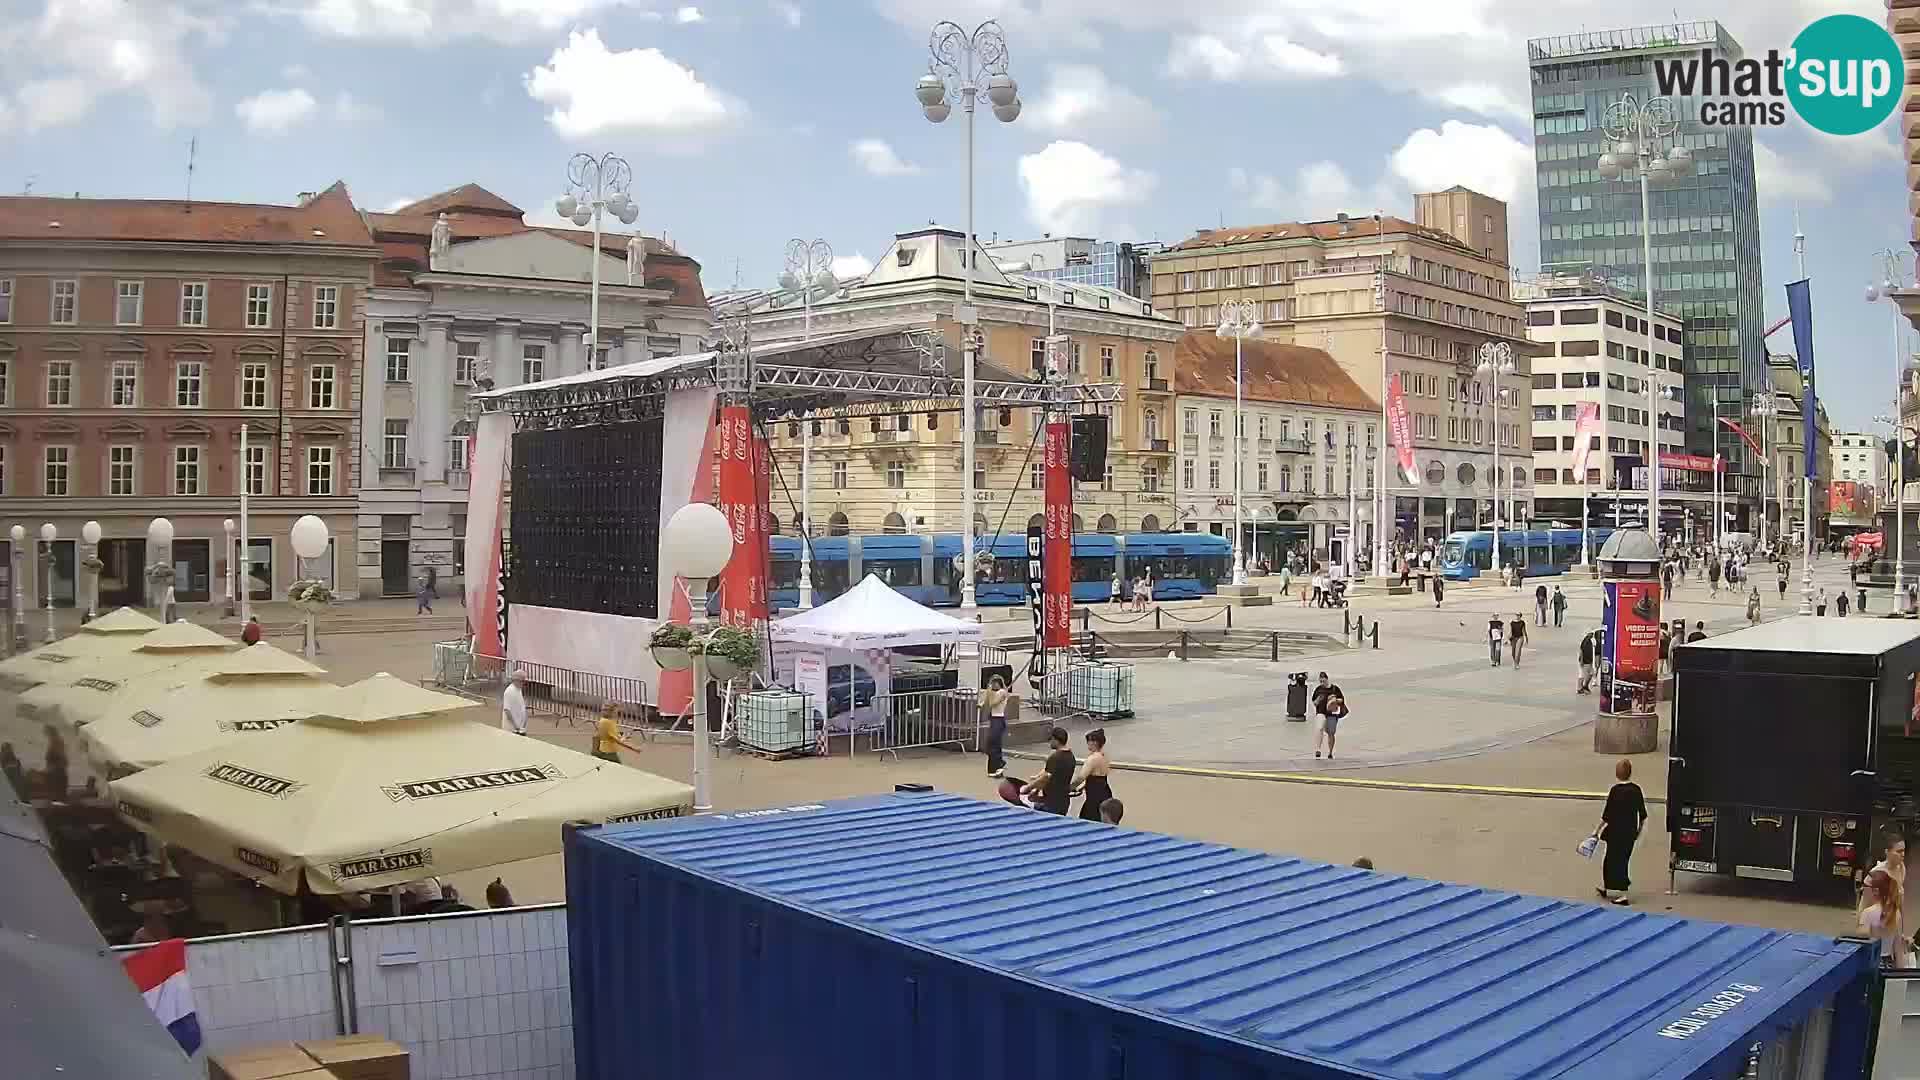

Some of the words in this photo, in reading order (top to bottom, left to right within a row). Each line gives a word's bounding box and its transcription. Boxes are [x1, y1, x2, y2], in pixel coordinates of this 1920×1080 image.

[217, 766, 284, 793] MARASKA
[413, 770, 538, 796] MARASKA
[344, 854, 419, 877] MARASKA
[1691, 990, 1746, 1019] 300629
